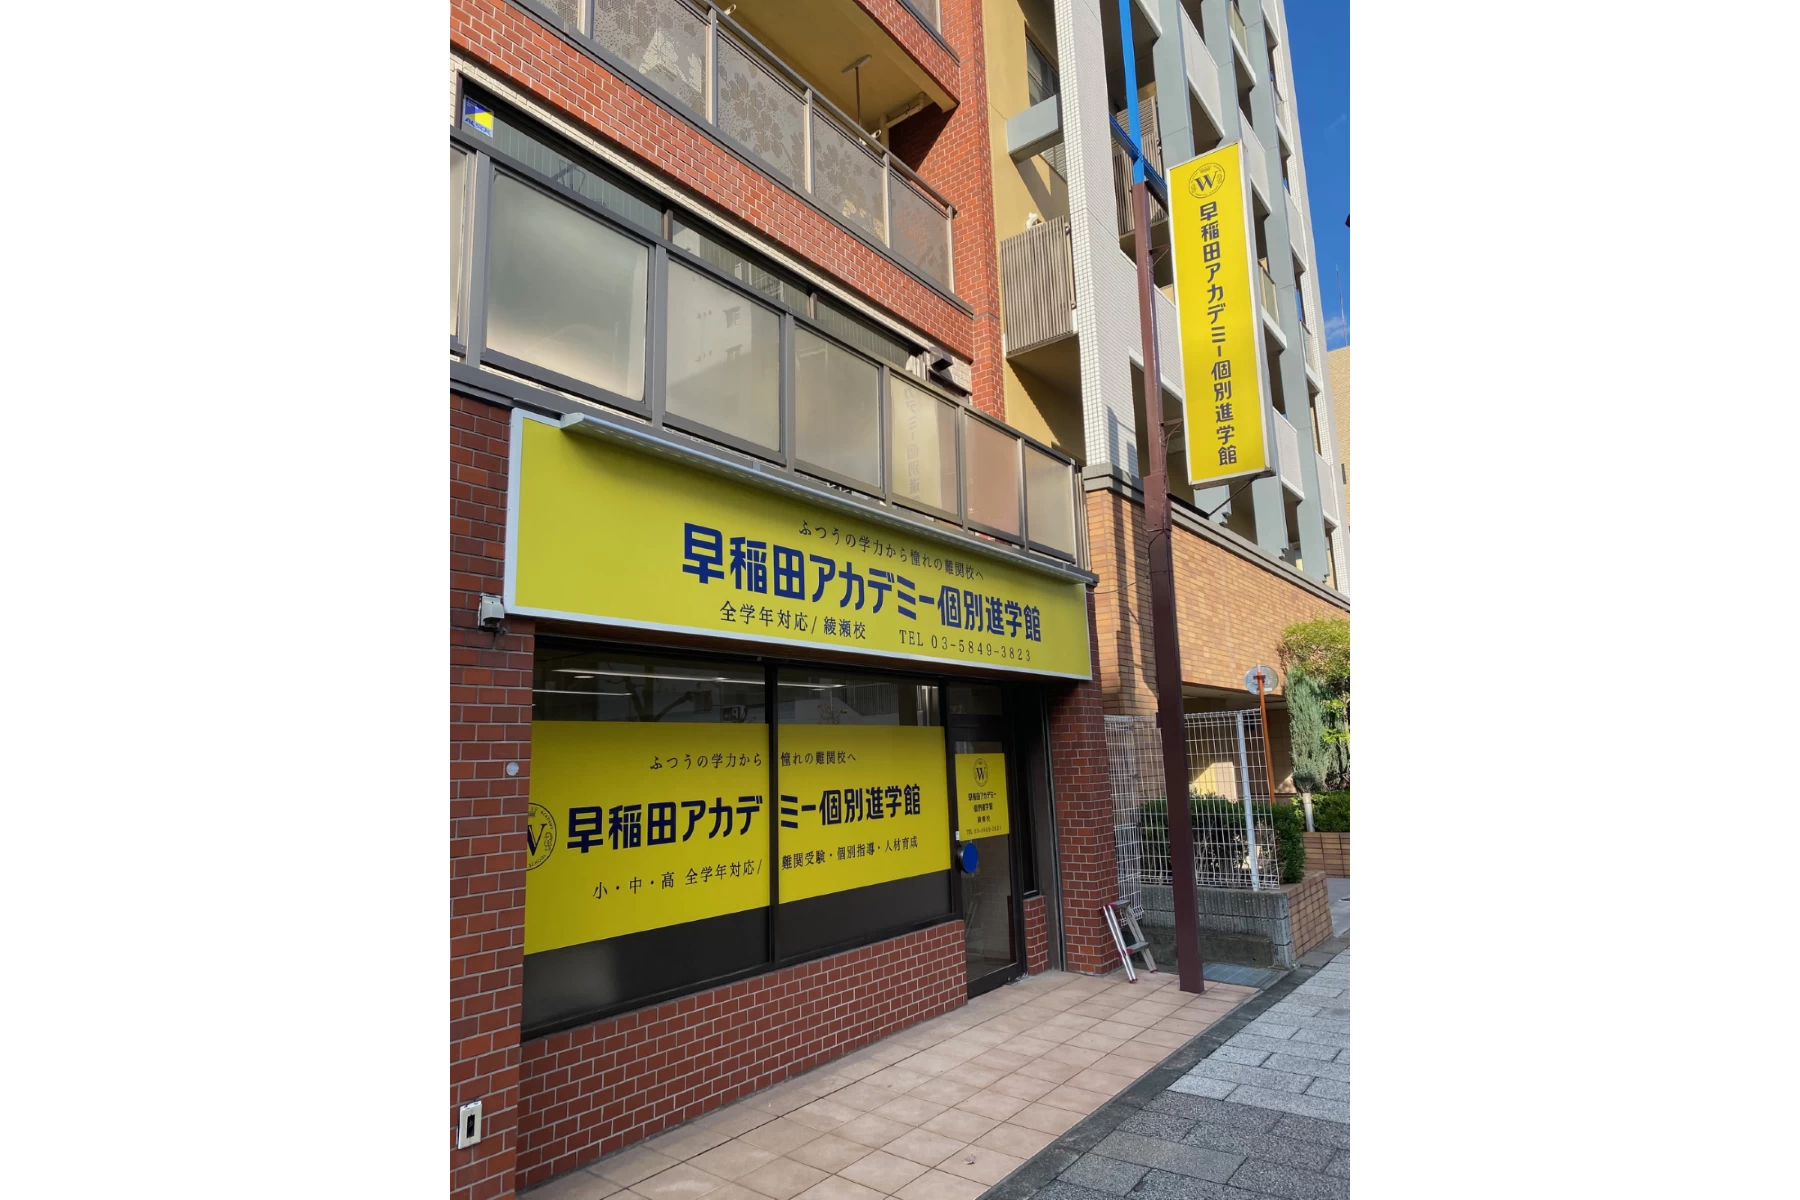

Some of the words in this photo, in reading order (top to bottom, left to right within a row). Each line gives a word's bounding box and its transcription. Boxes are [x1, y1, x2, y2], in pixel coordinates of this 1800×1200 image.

[465, 117, 491, 136] ALSOK
[1195, 171, 1218, 192] W
[1199, 201, 1238, 467] 早稲田アカデミー個別進学館
[798, 520, 984, 581] ふつうの学力から憧れの難関校へ
[682, 523, 1042, 643] 早稲田アカデミー個別進学館
[823, 616, 866, 640] 綾瀬校
[898, 630, 924, 647] TEL
[931, 634, 1032, 662] 03-5849-3823
[650, 753, 762, 770] ふつうの学力から
[780, 751, 857, 771] 憧れの難関校へ
[567, 795, 764, 854] 早稲田アカデ
[781, 784, 922, 830] ミー個別進学館
[782, 835, 920, 871] 難関受験・個別指導・人材育成
